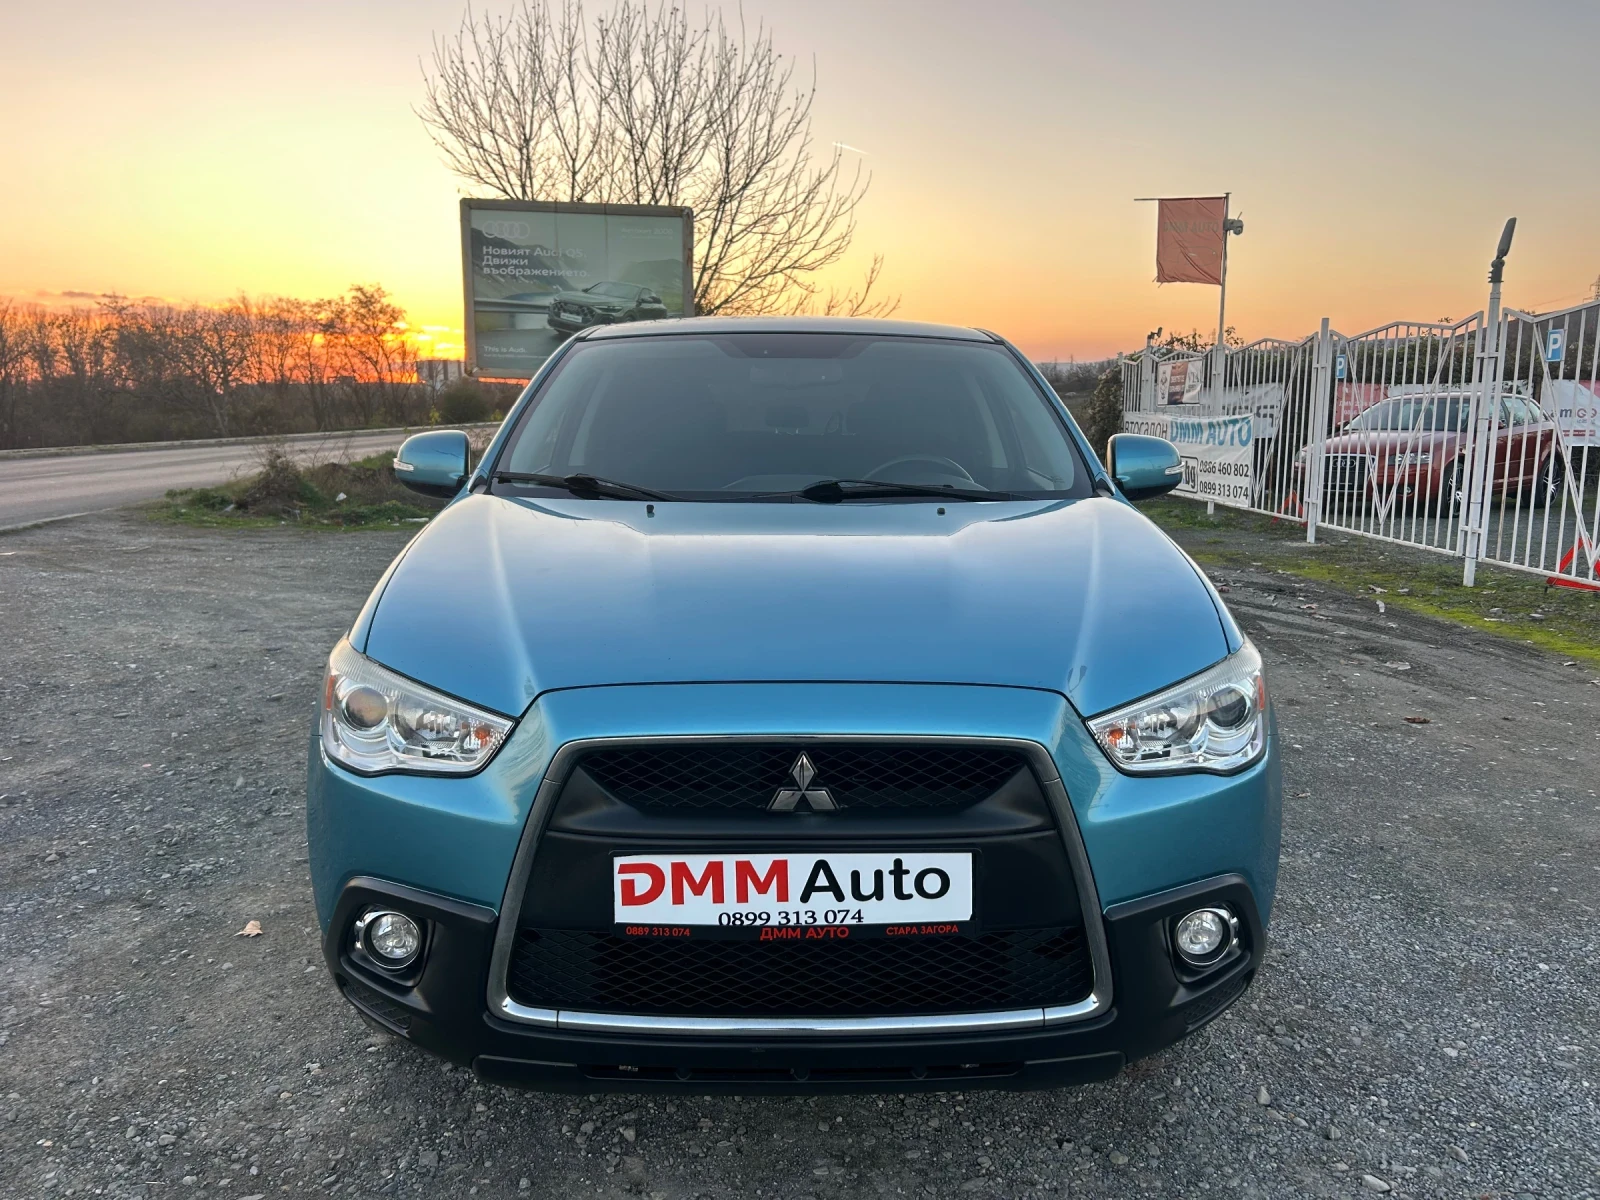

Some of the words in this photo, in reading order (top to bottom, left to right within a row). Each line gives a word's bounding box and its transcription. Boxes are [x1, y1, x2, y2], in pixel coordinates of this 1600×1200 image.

[482, 246, 530, 256] Новият
[533, 247, 562, 257] Audi
[482, 256, 529, 266] Движи
[483, 267, 592, 277] въображението.
[1548, 333, 1561, 359] P
[1336, 359, 1344, 377] P
[1170, 420, 1203, 445] DMM
[1205, 416, 1252, 447] AUTO
[1199, 460, 1217, 474] 0886
[1218, 461, 1232, 476] 460
[1233, 463, 1250, 478] 802
[1199, 480, 1217, 495] 0899
[1218, 482, 1231, 498] 313
[1232, 485, 1249, 500] 074
[617, 859, 789, 907] DMM
[799, 857, 951, 904] Auto
[718, 911, 772, 926] 0899
[777, 910, 818, 925] 313
[824, 909, 865, 924] 074
[625, 926, 649, 936] 0889
[650, 927, 670, 937] 313
[672, 928, 691, 937] 074
[760, 928, 801, 941] ДММ
[805, 926, 849, 939] АУТО
[886, 925, 918, 936] СТАРА
[920, 924, 959, 935] ЗАГОРА
